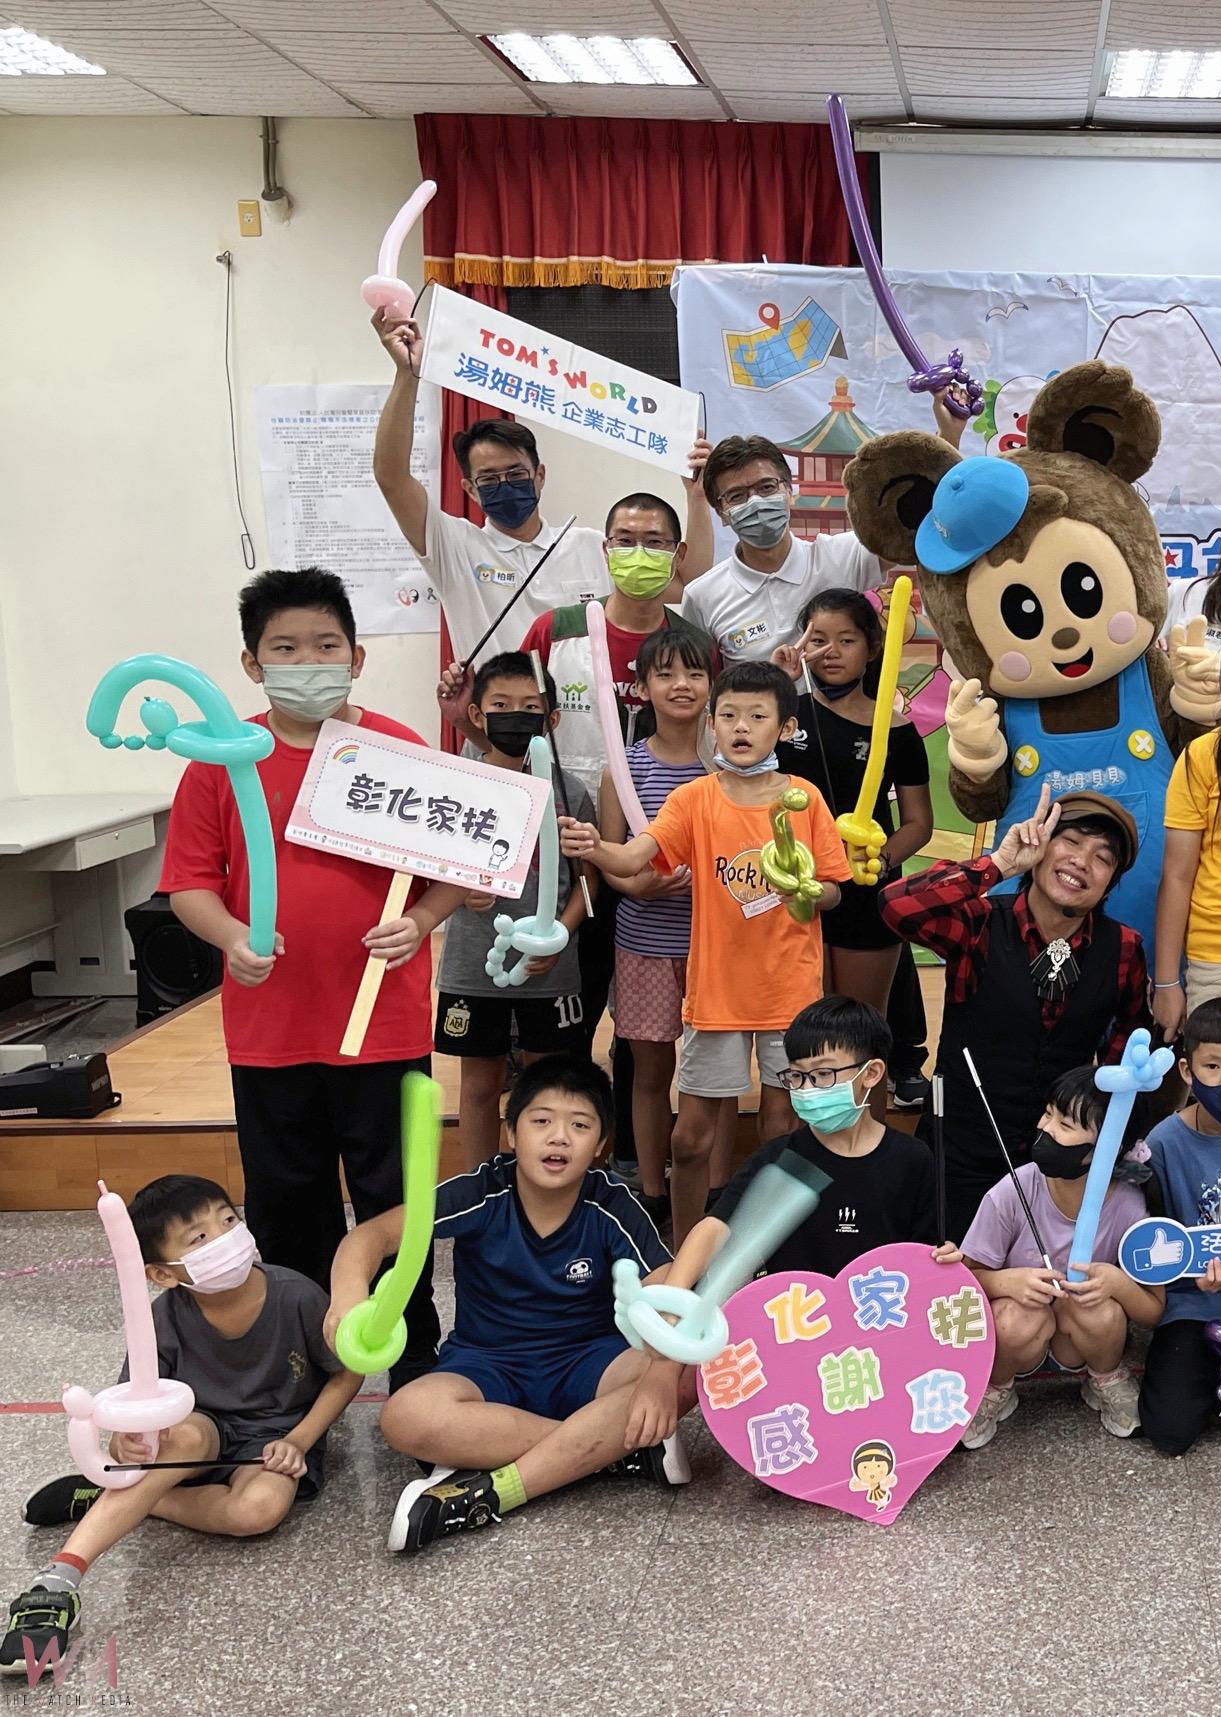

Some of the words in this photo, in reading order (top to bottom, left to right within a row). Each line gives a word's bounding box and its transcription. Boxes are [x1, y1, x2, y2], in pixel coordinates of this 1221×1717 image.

[454, 352, 556, 415] 湯姆熊
[561, 401, 669, 455] 企業志工隊
[563, 371, 658, 415] WORLD
[346, 773, 499, 842] 彰化家扶
[715, 856, 757, 889] Rock
[554, 994, 583, 1029] 10
